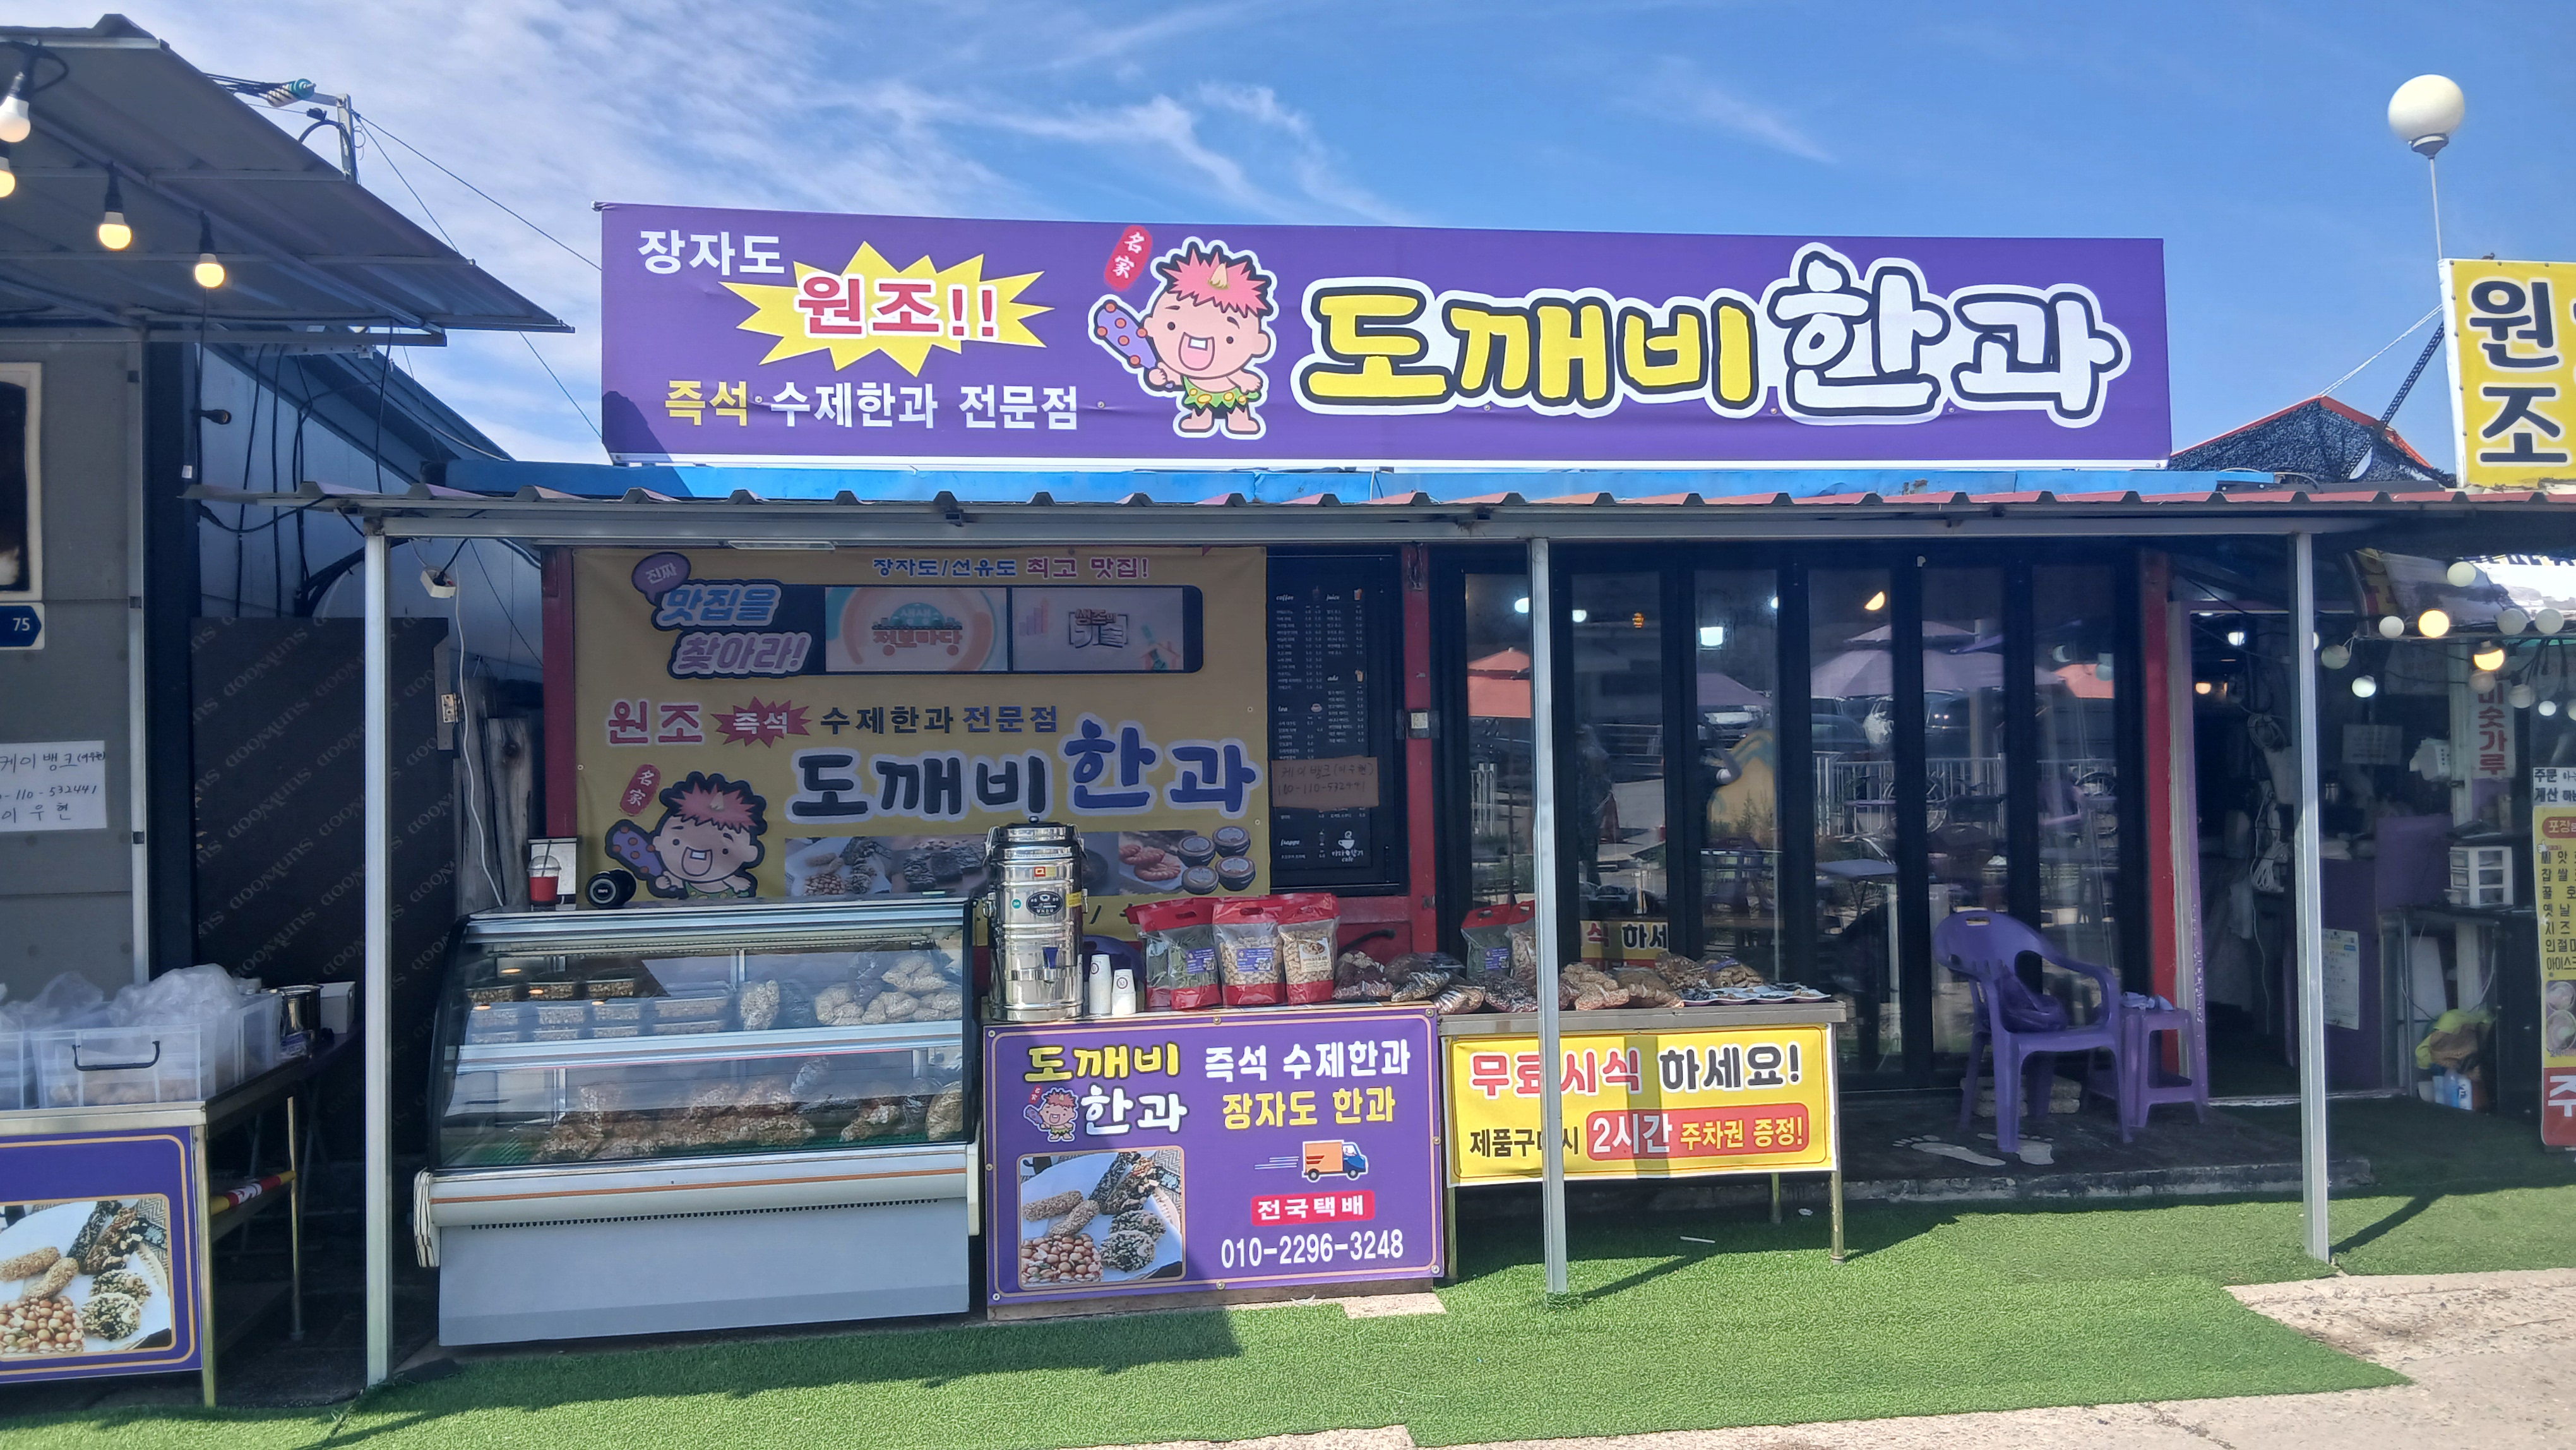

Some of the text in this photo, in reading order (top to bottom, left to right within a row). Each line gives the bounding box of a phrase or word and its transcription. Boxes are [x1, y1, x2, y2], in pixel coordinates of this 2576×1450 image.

[638, 229, 785, 276] 장자도
[796, 273, 998, 340] 원조!!
[2468, 279, 2568, 464] 원조
[664, 380, 1078, 430] 즉석 수제한과 전문점
[645, 562, 678, 585] 진짜
[1027, 557, 1078, 578] 최고
[1090, 557, 1149, 579] 맛집!
[658, 586, 779, 624] 맛집을
[1074, 608, 1117, 626] 생존의
[13, 618, 30, 632] 75
[873, 629, 963, 656] 정보마당
[1073, 624, 1124, 649] 기술
[677, 635, 808, 672] 찾아라!
[607, 700, 703, 746] 원조
[733, 712, 788, 735] 즉석
[962, 704, 1059, 733] 전문점
[2534, 768, 2558, 783] 주문
[2534, 788, 2558, 803] 계산
[1022, 1038, 1412, 1084] 도깨비 즉석 수제한과
[1659, 1043, 1801, 1091] 하세요!
[1078, 1083, 1397, 1137] 한과 장자도 한과
[1469, 1112, 1804, 1158] 제품구시 2시간 주차권 증정!
[1256, 1194, 1365, 1222] 전국택배
[1220, 1228, 1404, 1269] 010-2296-3248
